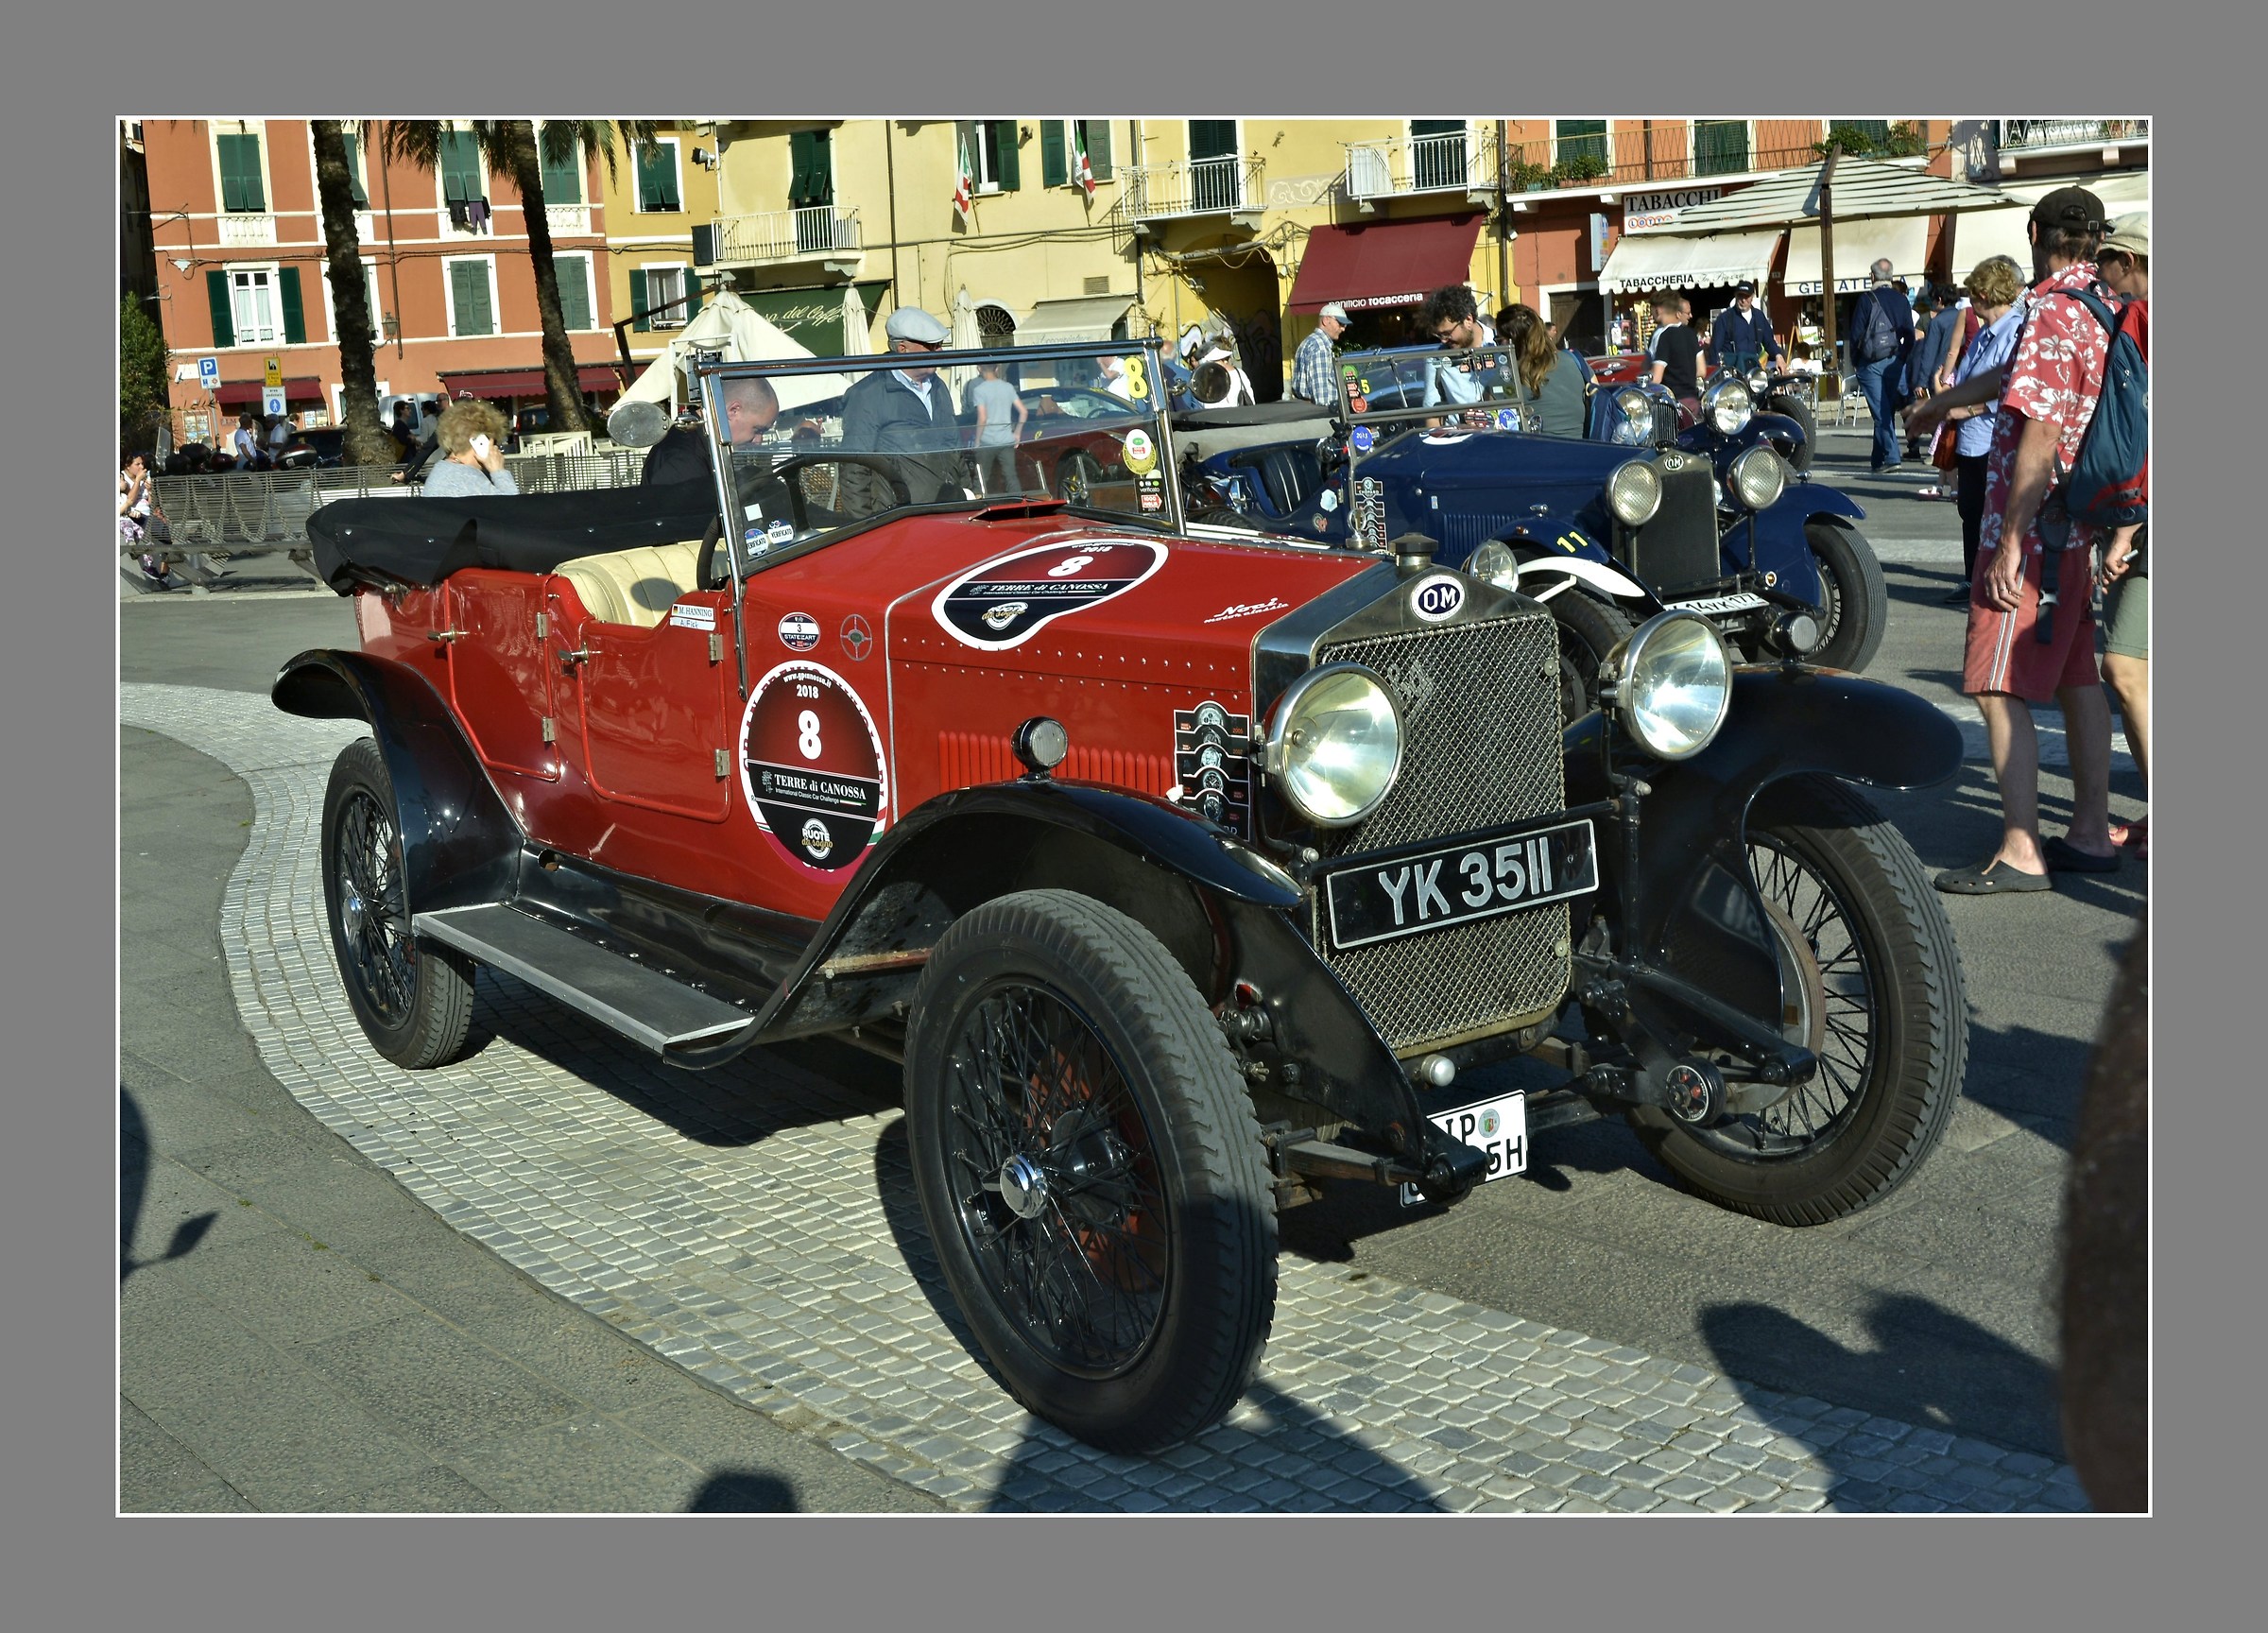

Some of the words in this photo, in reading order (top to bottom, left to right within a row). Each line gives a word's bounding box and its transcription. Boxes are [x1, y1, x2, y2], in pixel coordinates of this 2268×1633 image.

[1625, 190, 1720, 213] TABACCHI
[1628, 215, 1673, 229] LOTT
[1620, 274, 1694, 288] TABACCHERIA
[1799, 275, 1906, 293] GEATEA
[782, 305, 810, 318] del
[203, 361, 214, 374] P
[1124, 356, 1148, 399] 8
[1361, 379, 1370, 394] 5
[770, 528, 792, 539] VERIFICATO
[1556, 531, 1589, 553] 11
[1047, 555, 1094, 577] 8
[1423, 586, 1456, 611] OM
[797, 624, 801, 632] 3
[796, 683, 819, 699] 2018
[798, 709, 822, 761] 8
[774, 773, 807, 791] TERRE
[809, 780, 818, 792] di
[819, 782, 867, 799] CANOSSA
[801, 828, 831, 842] RUOTE
[812, 838, 833, 851] sogno
[1378, 859, 1451, 925] YK
[1459, 836, 1553, 908] 3511
